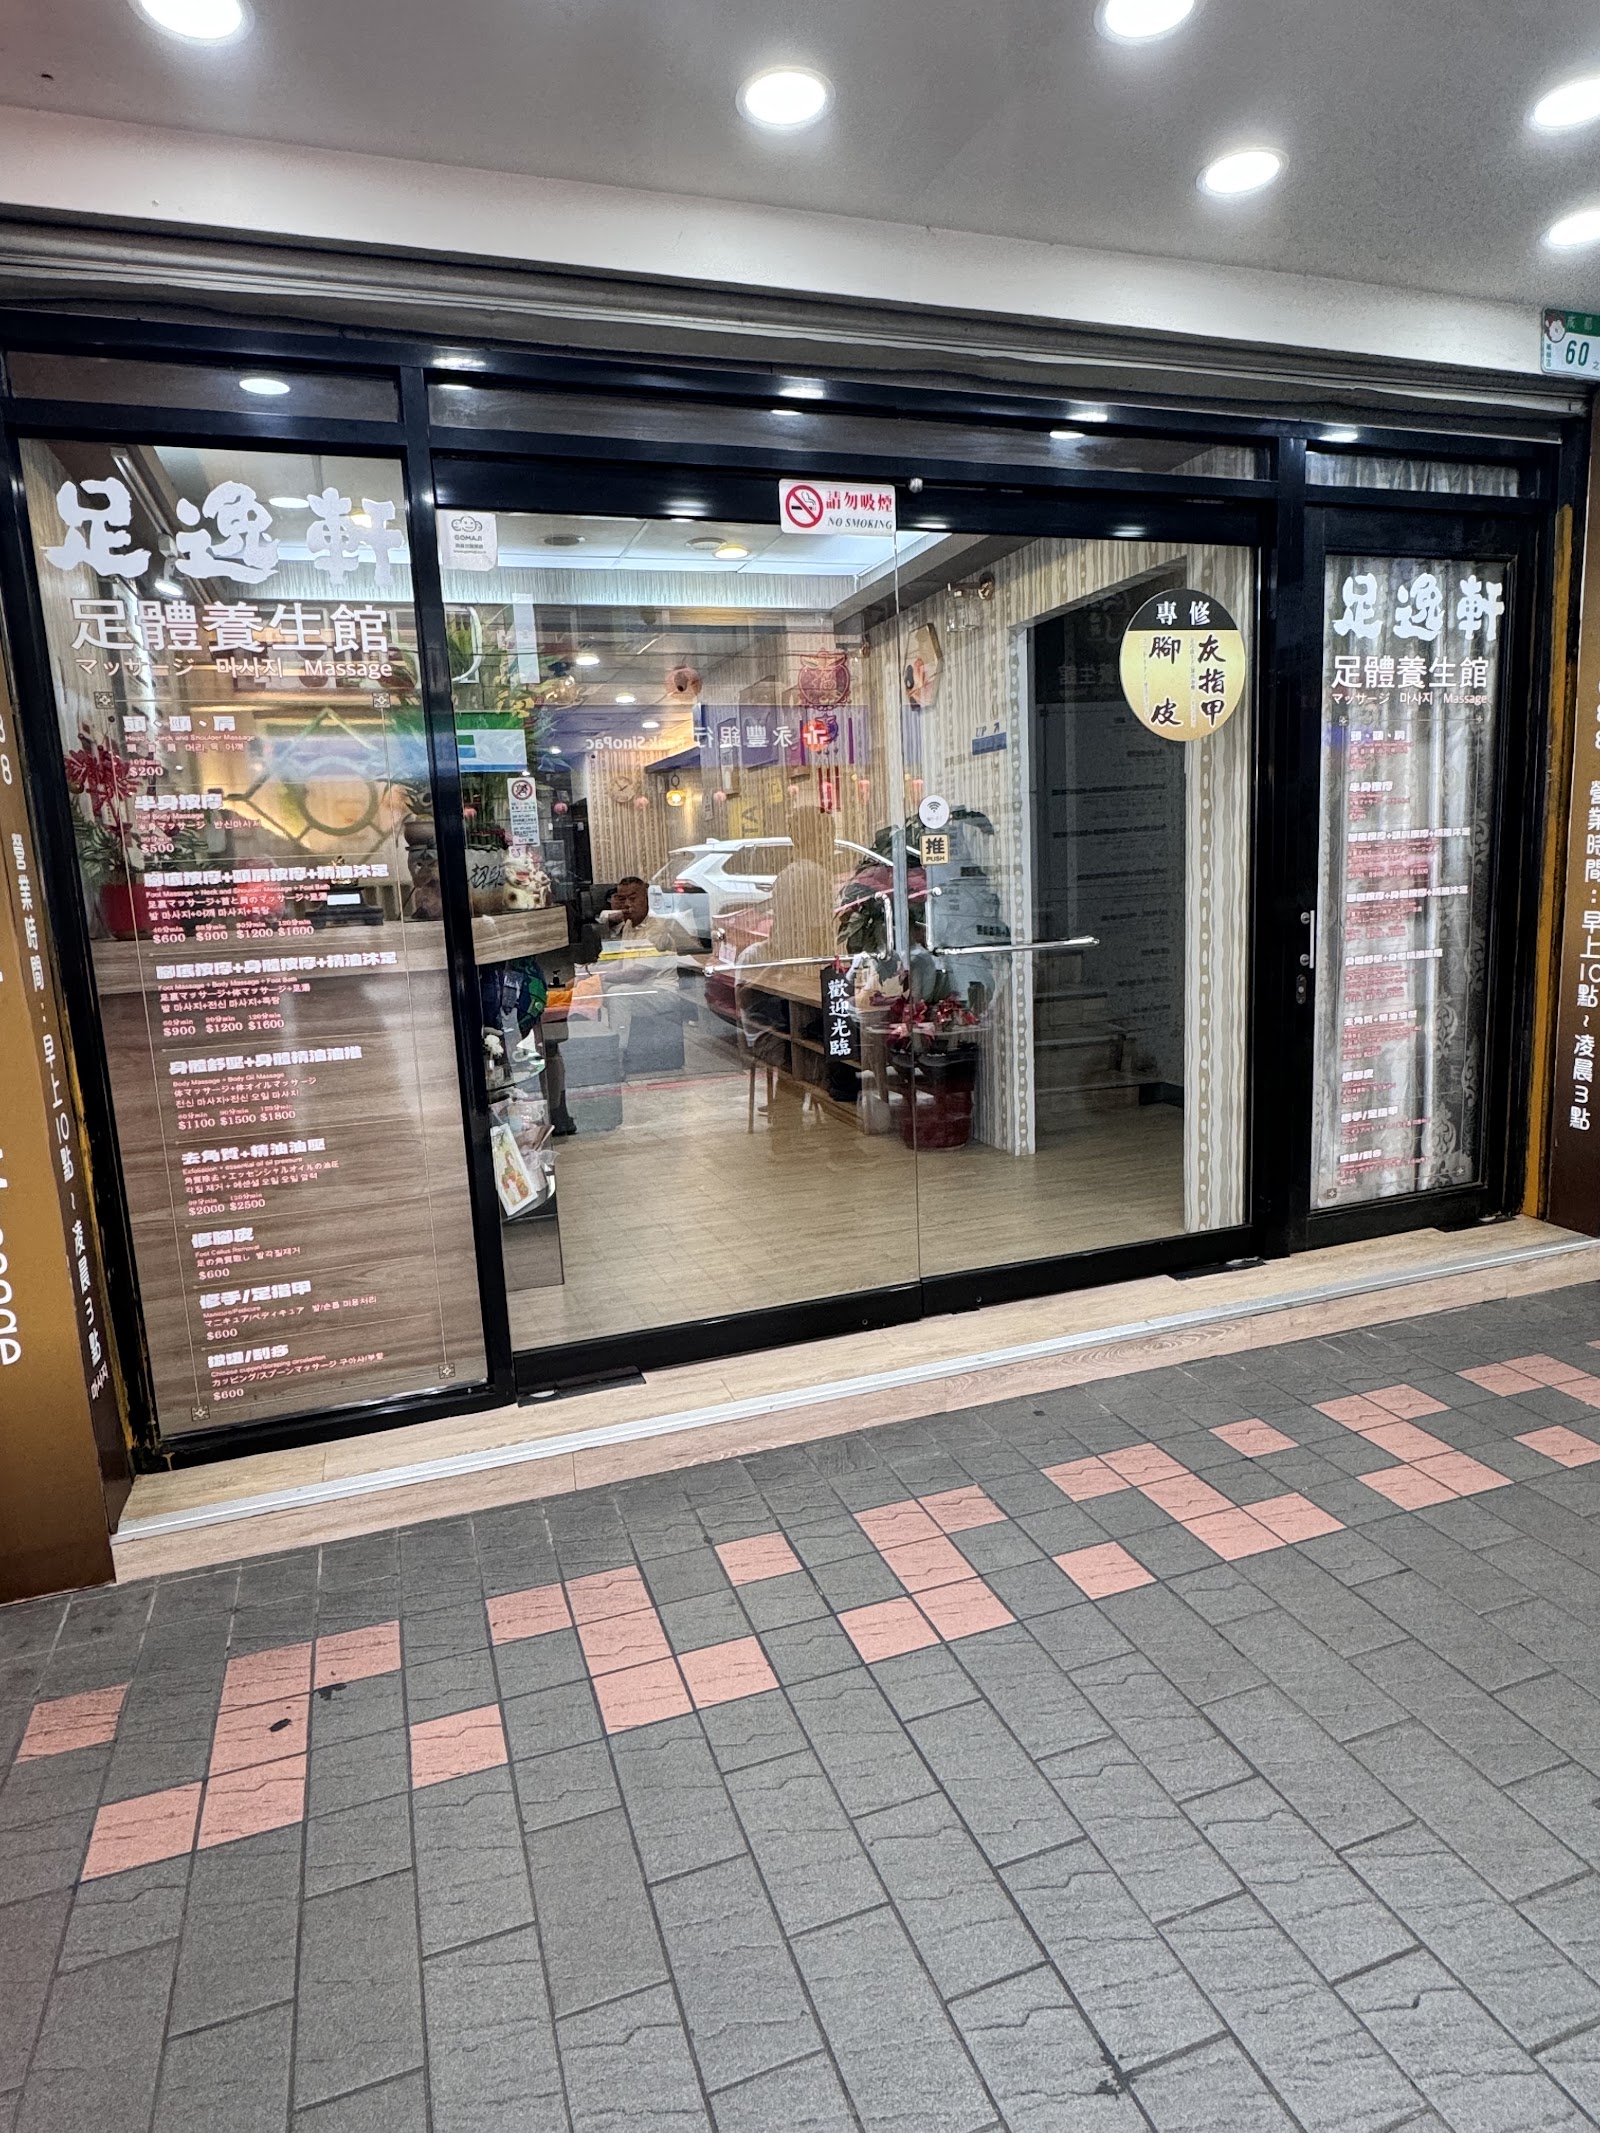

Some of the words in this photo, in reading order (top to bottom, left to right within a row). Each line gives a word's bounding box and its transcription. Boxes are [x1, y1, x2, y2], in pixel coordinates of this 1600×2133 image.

[1565, 340, 1589, 366] 60
[826, 491, 892, 512] 請勿吸煙
[828, 517, 842, 527] NO
[845, 518, 893, 529] SMOKING
[1156, 601, 1211, 625] 專修
[71, 599, 388, 653] 足體養生館
[76, 657, 194, 676] マッサージ
[216, 656, 283, 678] 마사지
[304, 660, 393, 679] Massage
[1331, 655, 1489, 689] 足體養生館
[1197, 634, 1226, 726] 灰指甲
[1332, 693, 1390, 705] マッサージ
[1400, 691, 1433, 705] 마사지
[1443, 693, 1488, 705] Massage
[975, 725, 987, 737] UP
[129, 766, 164, 777] $200
[141, 843, 175, 853] $500
[925, 837, 945, 855] 推
[153, 933, 186, 944] $600
[195, 931, 228, 942] $900
[236, 928, 273, 939] $1200
[278, 926, 314, 937] $1600
[827, 978, 852, 1057] 歡迎光臨
[163, 1025, 196, 1037] $900
[205, 1022, 243, 1034] $1200
[248, 1019, 285, 1031] $1600
[178, 1118, 216, 1130] $1100
[219, 1114, 257, 1126] $1500
[260, 1110, 296, 1122] $1800
[188, 1203, 225, 1216] $2000
[229, 1198, 266, 1211] $2500
[198, 1268, 230, 1281] $600
[206, 1328, 238, 1341] $600
[213, 1388, 244, 1401] $600
